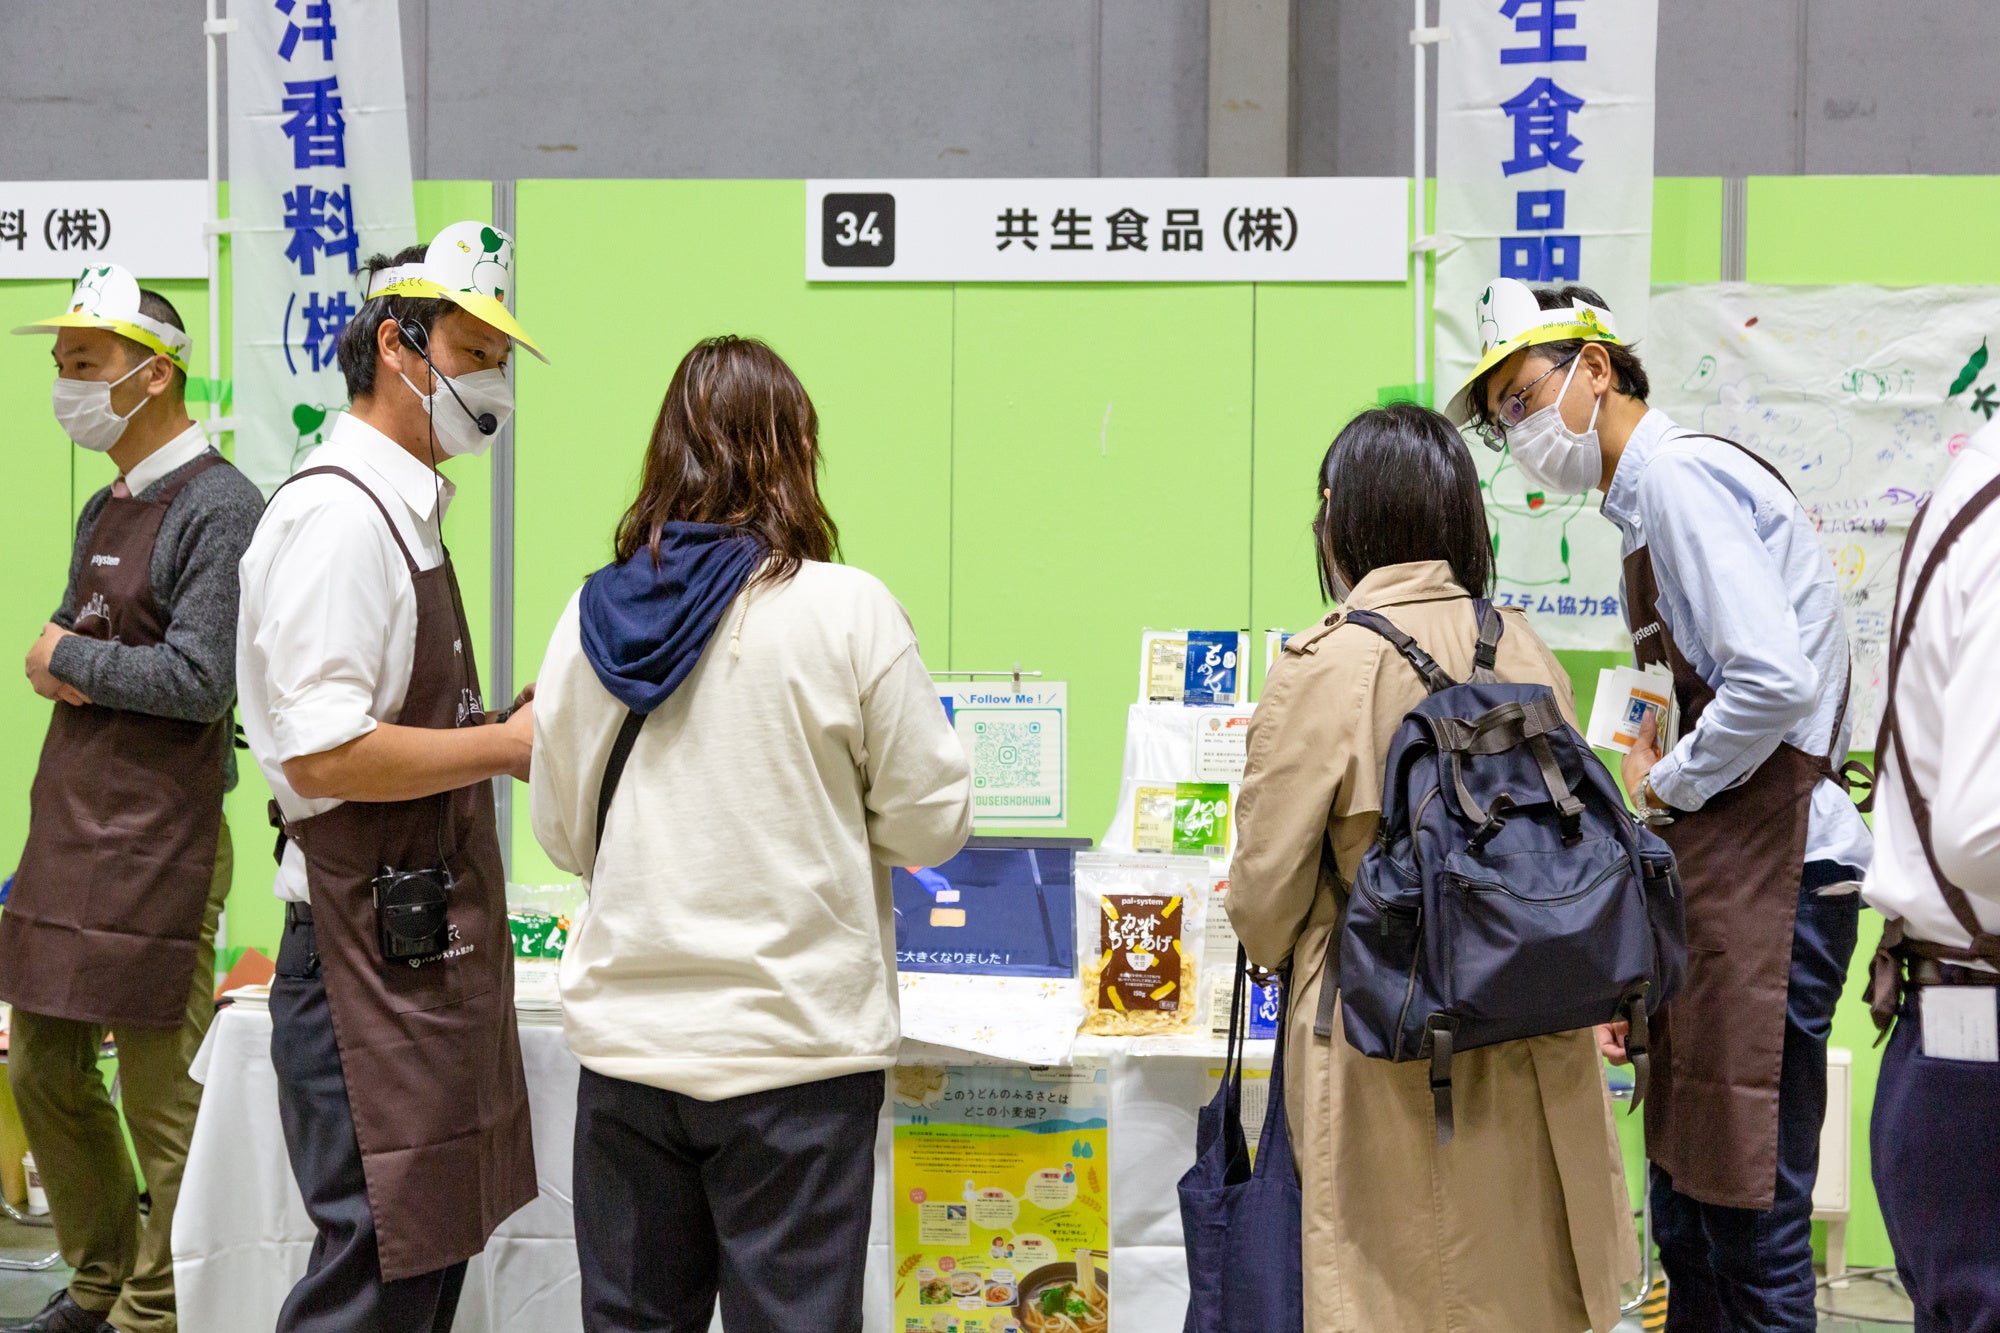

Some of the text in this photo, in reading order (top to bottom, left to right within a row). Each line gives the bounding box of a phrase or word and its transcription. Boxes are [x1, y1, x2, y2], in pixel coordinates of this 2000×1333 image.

[835, 210, 883, 248] 34
[995, 206, 1299, 253] 共生食品(株)
[970, 694, 1011, 704] Follow
[1015, 694, 1034, 704] Me
[944, 1088, 1069, 1105] このうどんのふるさとは
[964, 1106, 1048, 1120] どこの小麦畑?
